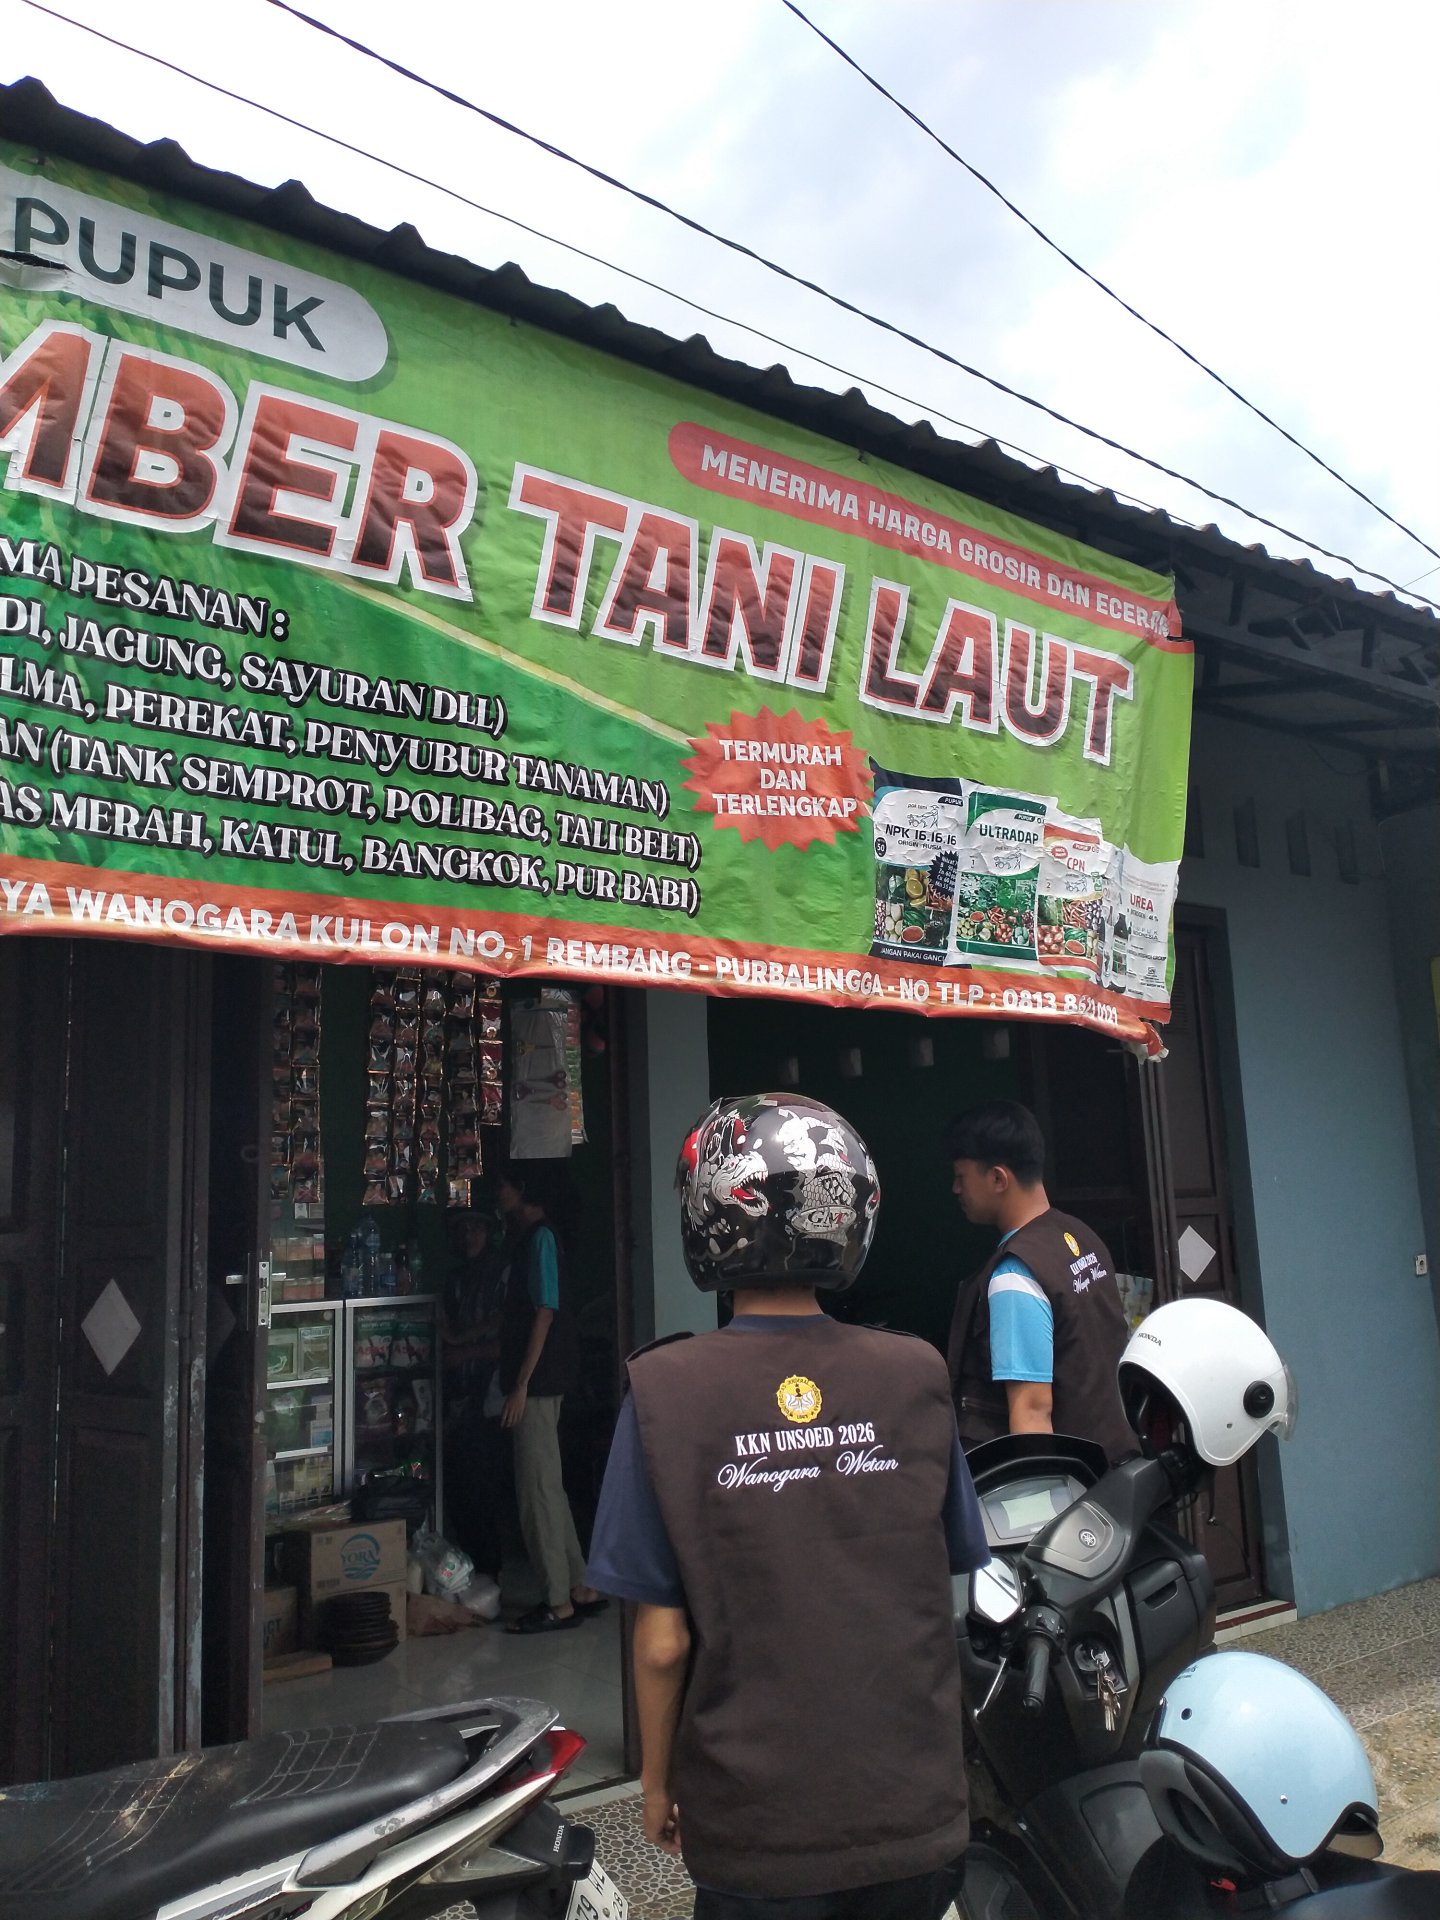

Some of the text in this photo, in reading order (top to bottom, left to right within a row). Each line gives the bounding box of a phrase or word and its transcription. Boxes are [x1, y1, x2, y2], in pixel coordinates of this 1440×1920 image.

[14, 197, 326, 352] PUPUK
[702, 444, 858, 520] MENERIMA
[868, 500, 952, 553] HARGA
[958, 537, 1041, 590] GROSIR
[1047, 573, 1090, 608] DAN
[509, 463, 844, 691] TANI
[860, 580, 1133, 762] LAUT
[60, 614, 231, 687] JAGUNG,
[241, 655, 425, 716] SAYURAN
[433, 688, 504, 736] DLL)
[106, 683, 296, 753] PEREKAT,
[305, 724, 506, 782] PENYUBUR
[513, 756, 668, 817] TANAMAN)
[719, 739, 842, 766] TERMURAH
[51, 728, 172, 786] (TANK
[181, 756, 376, 820] SEMPROT,
[385, 787, 549, 843] POLIBAG,
[556, 812, 617, 852] TALI
[624, 826, 698, 868] BELT)
[760, 768, 807, 791] DAN
[712, 793, 858, 818] TERLENGKAP
[885, 824, 910, 839] NPK
[979, 823, 1039, 845] ULTRADAP
[51, 792, 213, 854] MERAH,
[222, 818, 354, 872] KATUL,
[363, 838, 549, 892] BANGKOK,
[556, 863, 616, 899] PUR
[623, 873, 699, 915] BABI)
[1066, 856, 1086, 872] CPN
[1130, 893, 1154, 912] UREA
[66, 886, 300, 943] WANOGARA
[310, 913, 440, 954] KULON
[450, 927, 513, 960] NO.
[521, 935, 532, 961] 1
[546, 937, 693, 979] REMBANG
[715, 955, 884, 998] PURBALINGGA
[899, 976, 930, 1002] NO
[937, 983, 984, 1008] TLP
[1002, 988, 1057, 1013] 0813
[734, 1422, 876, 1457] KKN UNSOED 2026
[717, 1444, 899, 1493] Wanogara Wetan
[552, 1824, 565, 1853] HONDA
